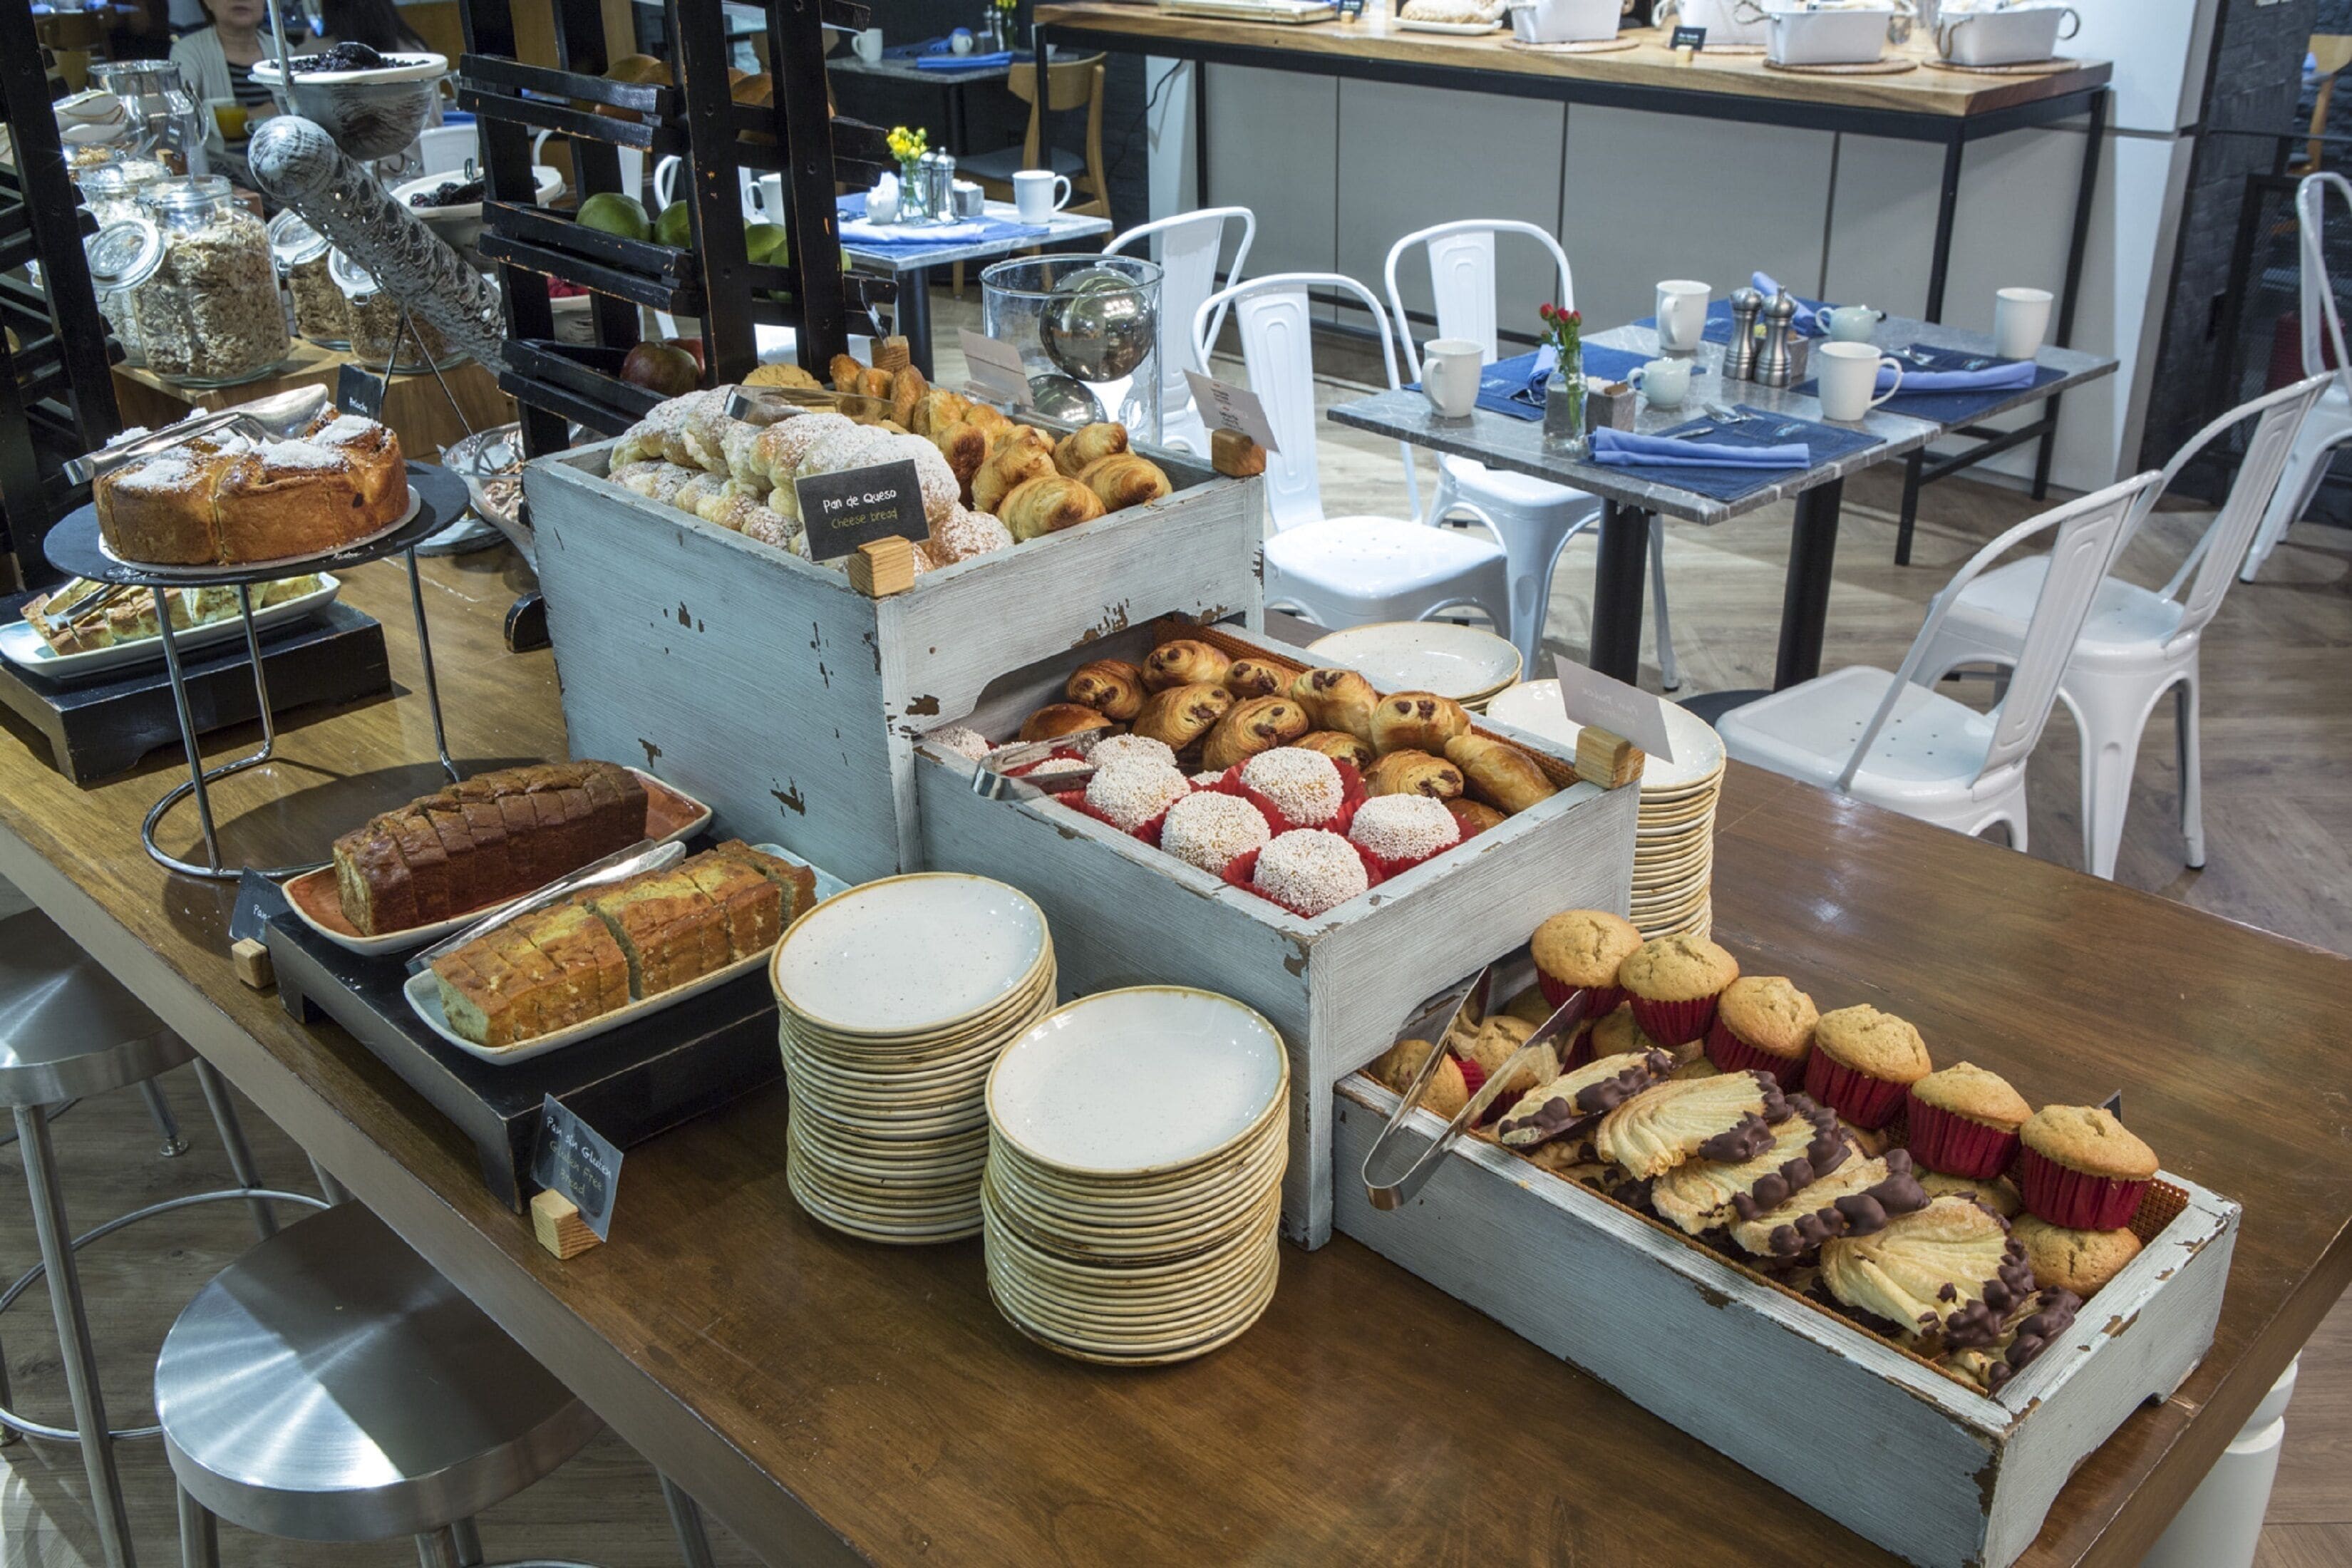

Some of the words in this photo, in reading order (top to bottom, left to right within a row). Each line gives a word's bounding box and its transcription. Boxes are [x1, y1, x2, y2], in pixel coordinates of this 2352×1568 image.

[823, 499, 842, 513] Pan
[846, 495, 860, 508] de
[863, 490, 897, 505] Queso
[870, 507, 898, 522] bread
[547, 1116, 562, 1137] Pan
[582, 1147, 611, 1180] Gluten
